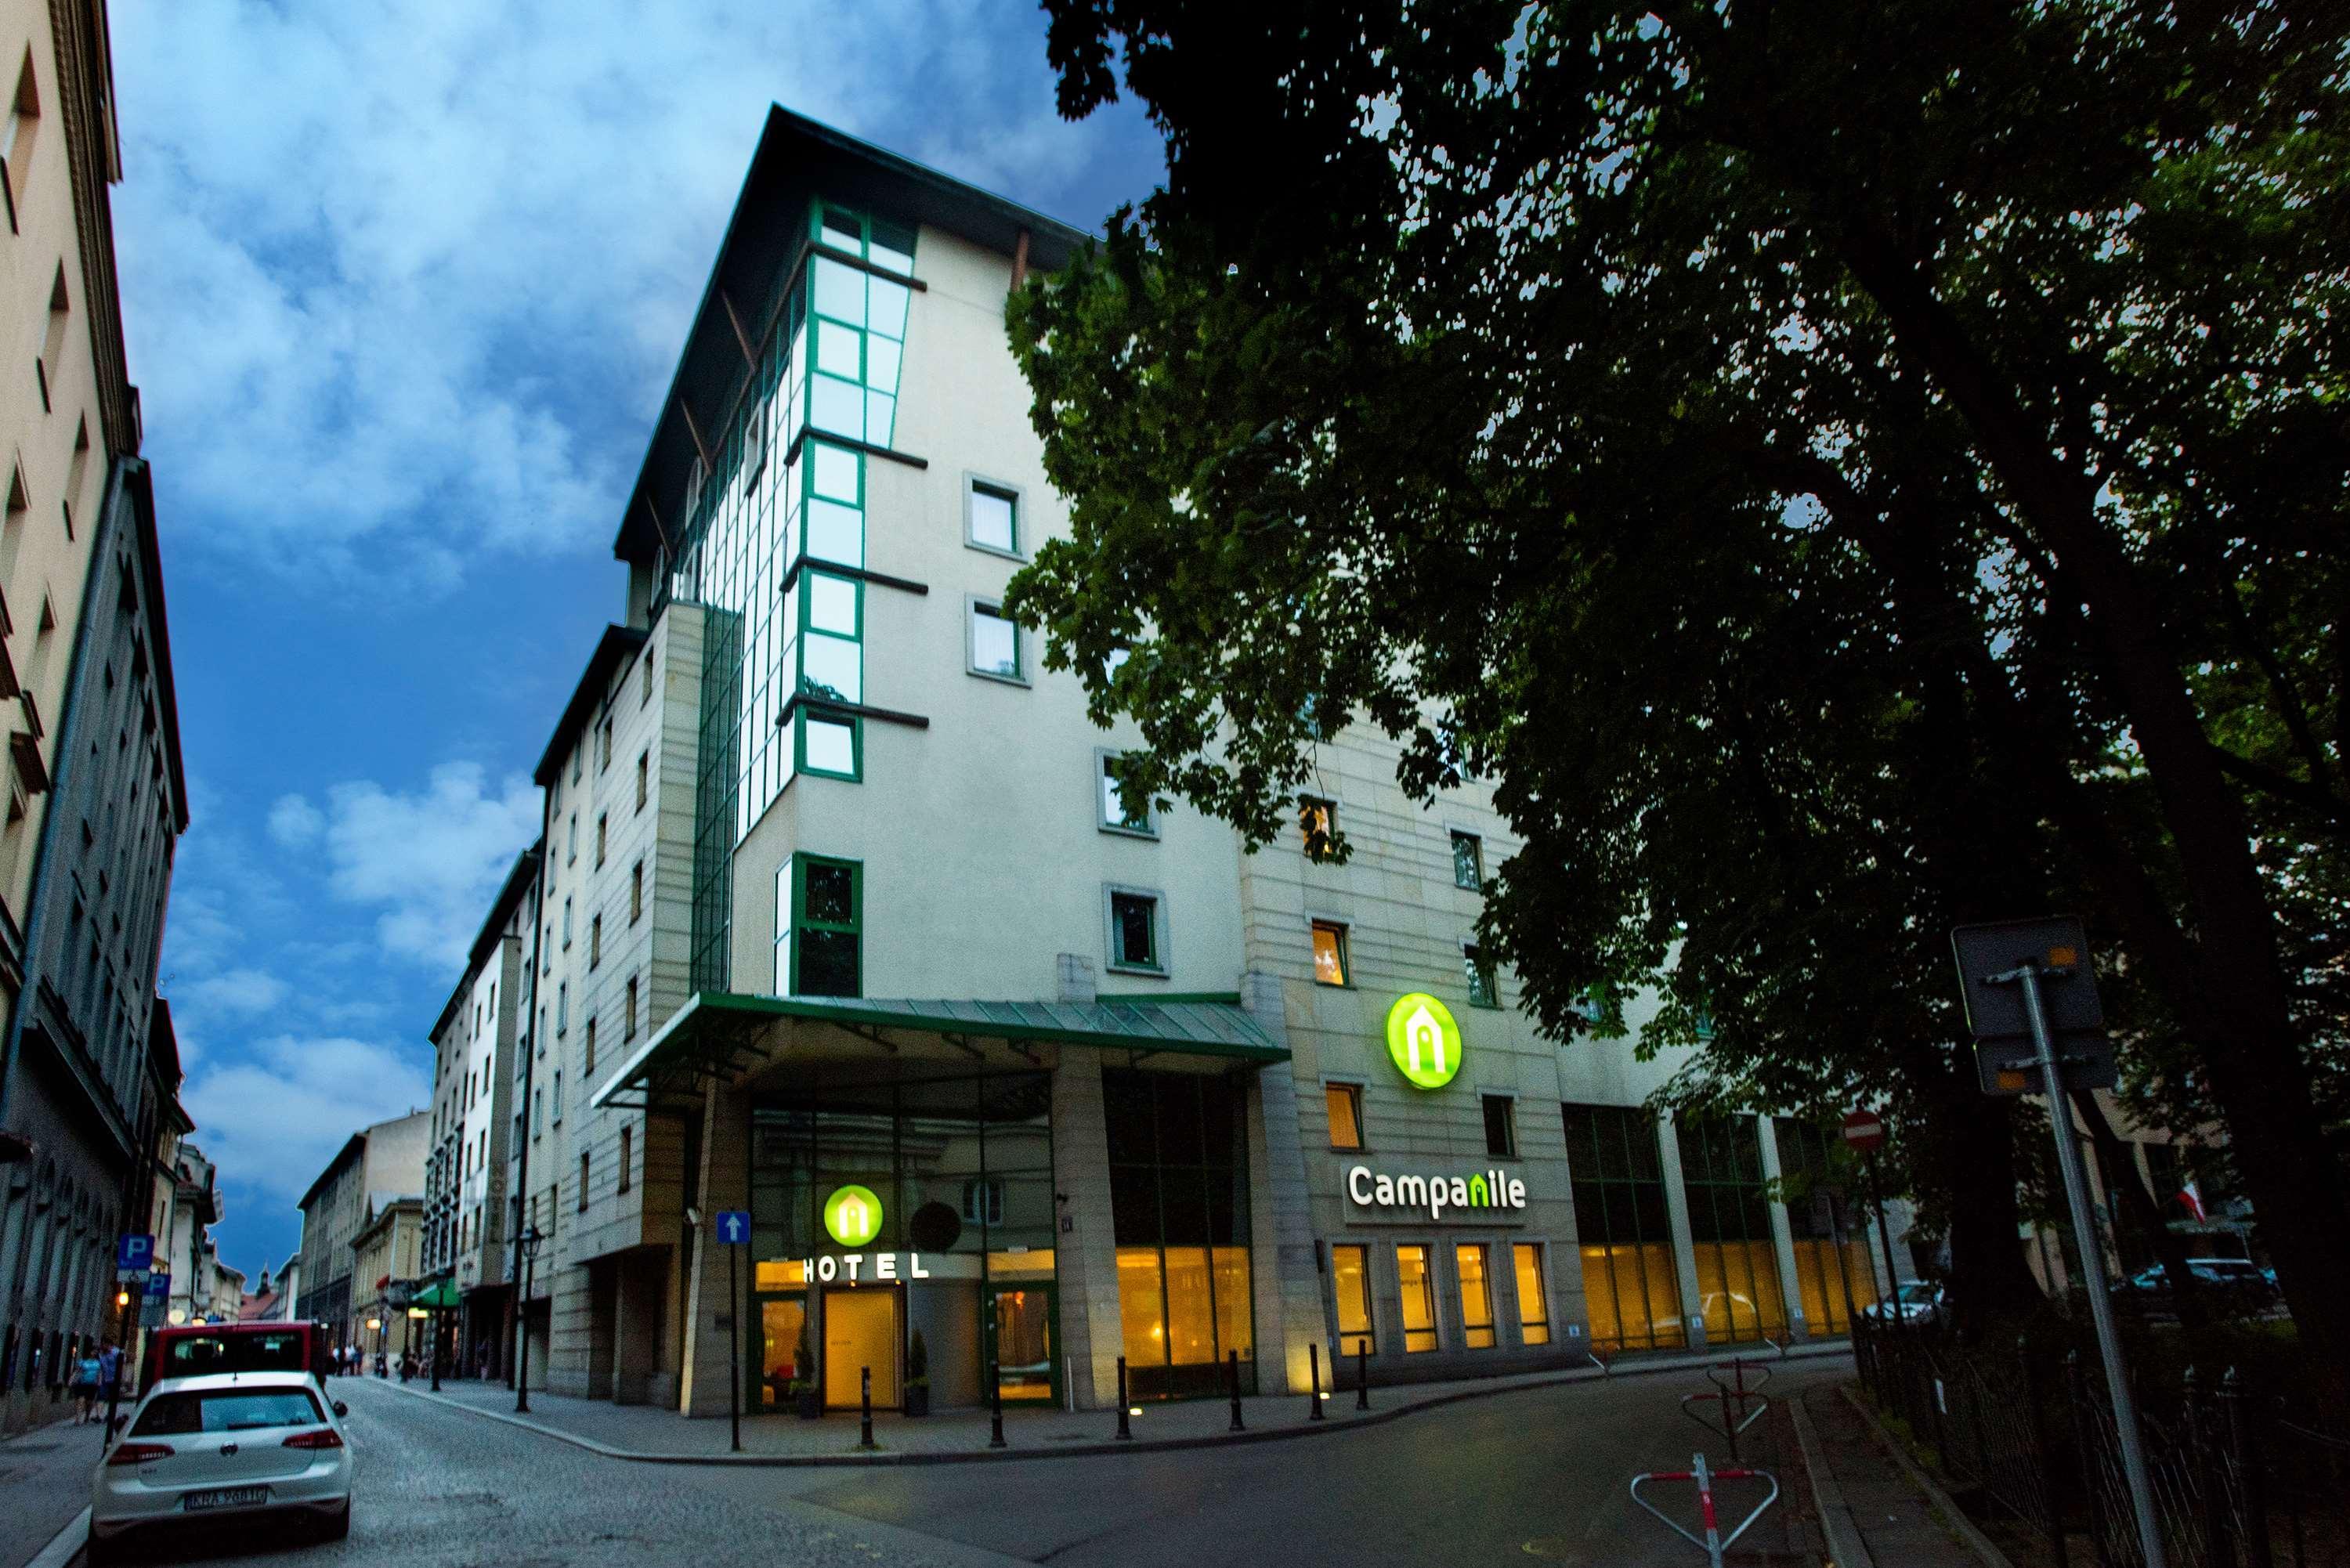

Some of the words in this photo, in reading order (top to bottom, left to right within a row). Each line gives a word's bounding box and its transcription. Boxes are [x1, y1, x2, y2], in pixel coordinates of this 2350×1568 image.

[1349, 1165, 1526, 1219] Campanile
[127, 1237, 148, 1259] P
[803, 1253, 930, 1283] HOTEL
[149, 1276, 166, 1294] P
